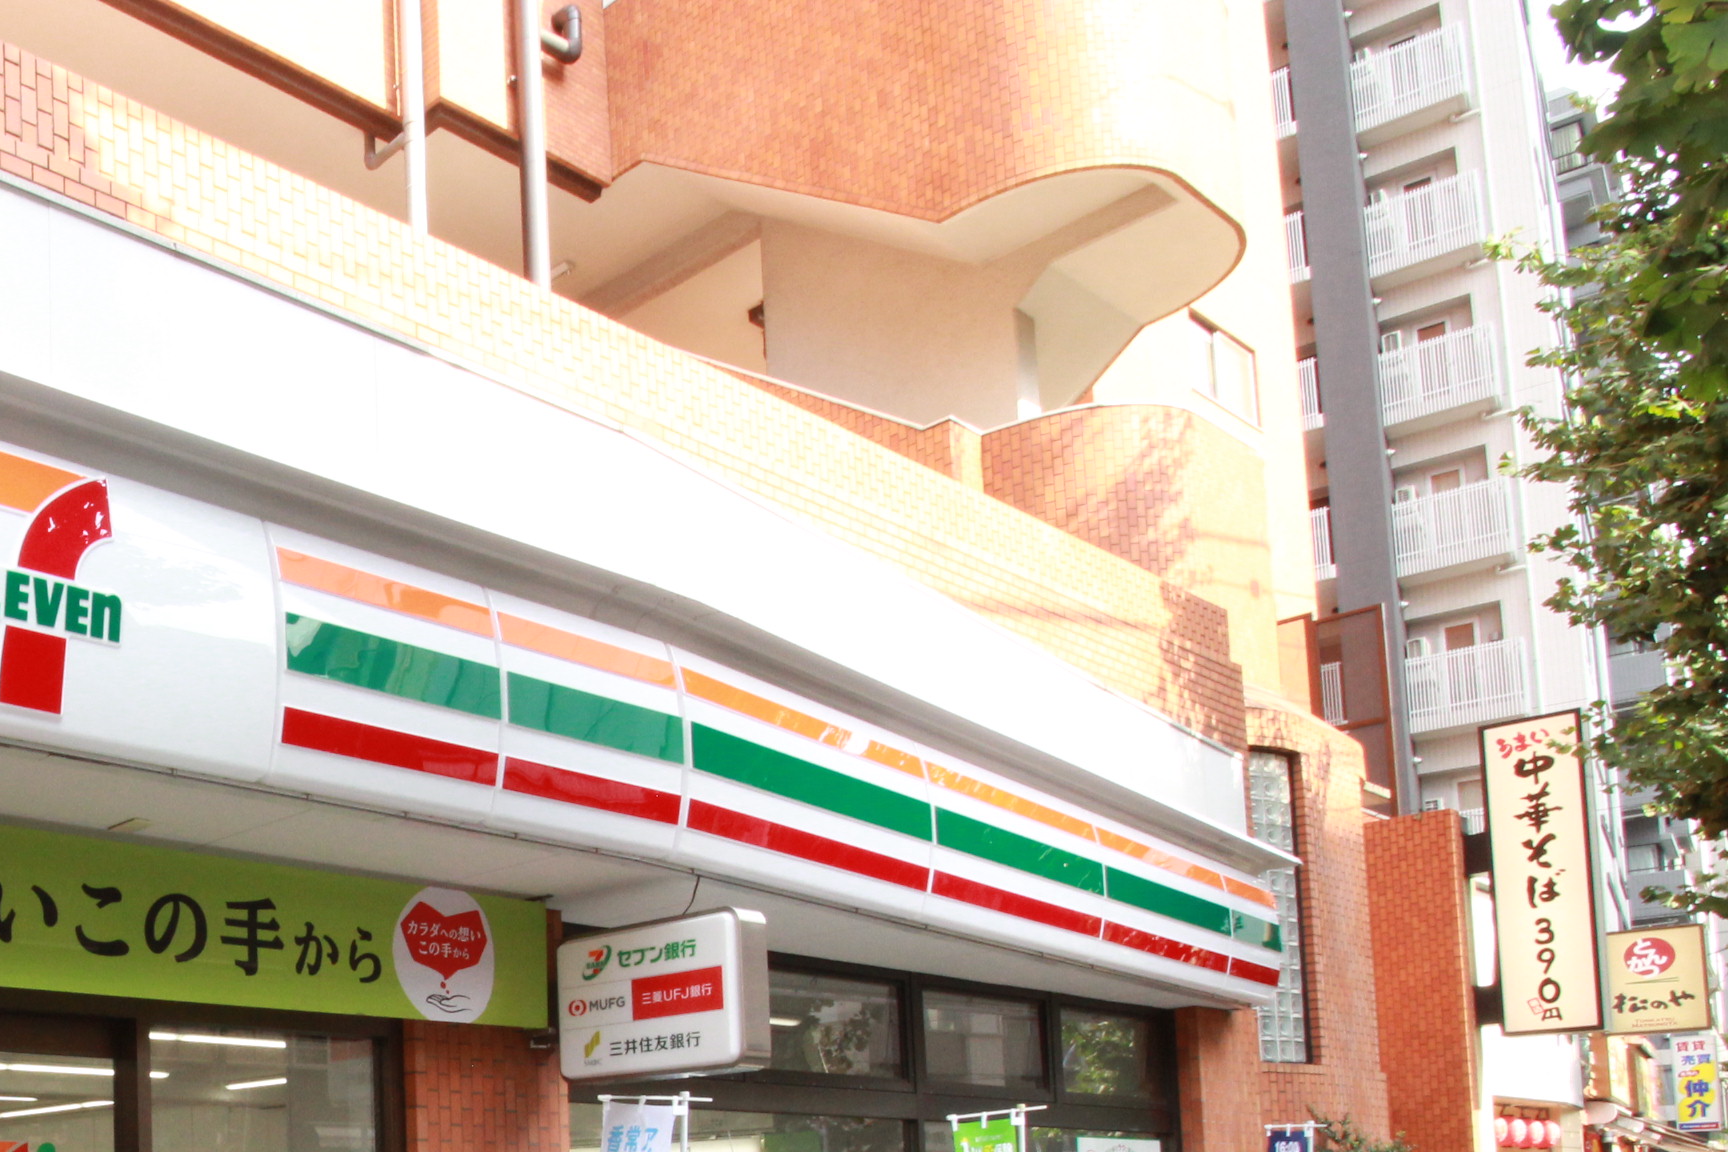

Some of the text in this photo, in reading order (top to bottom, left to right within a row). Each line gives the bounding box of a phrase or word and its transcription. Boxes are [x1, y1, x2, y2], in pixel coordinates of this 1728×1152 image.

[1496, 729, 1550, 759] うまい
[407, 920, 482, 943] カラダへの想い
[418, 941, 470, 960] この手から
[617, 939, 697, 968] セブン銀行
[589, 983, 713, 1012] MUFG 三菱UFJ銀行
[1612, 989, 1696, 1013] 松のや
[609, 1031, 701, 1057] 三井住友銀行
[1675, 1040, 1706, 1052] 賃貸
[1680, 1054, 1712, 1065] 売買
[1684, 1080, 1710, 1118] 仲介
